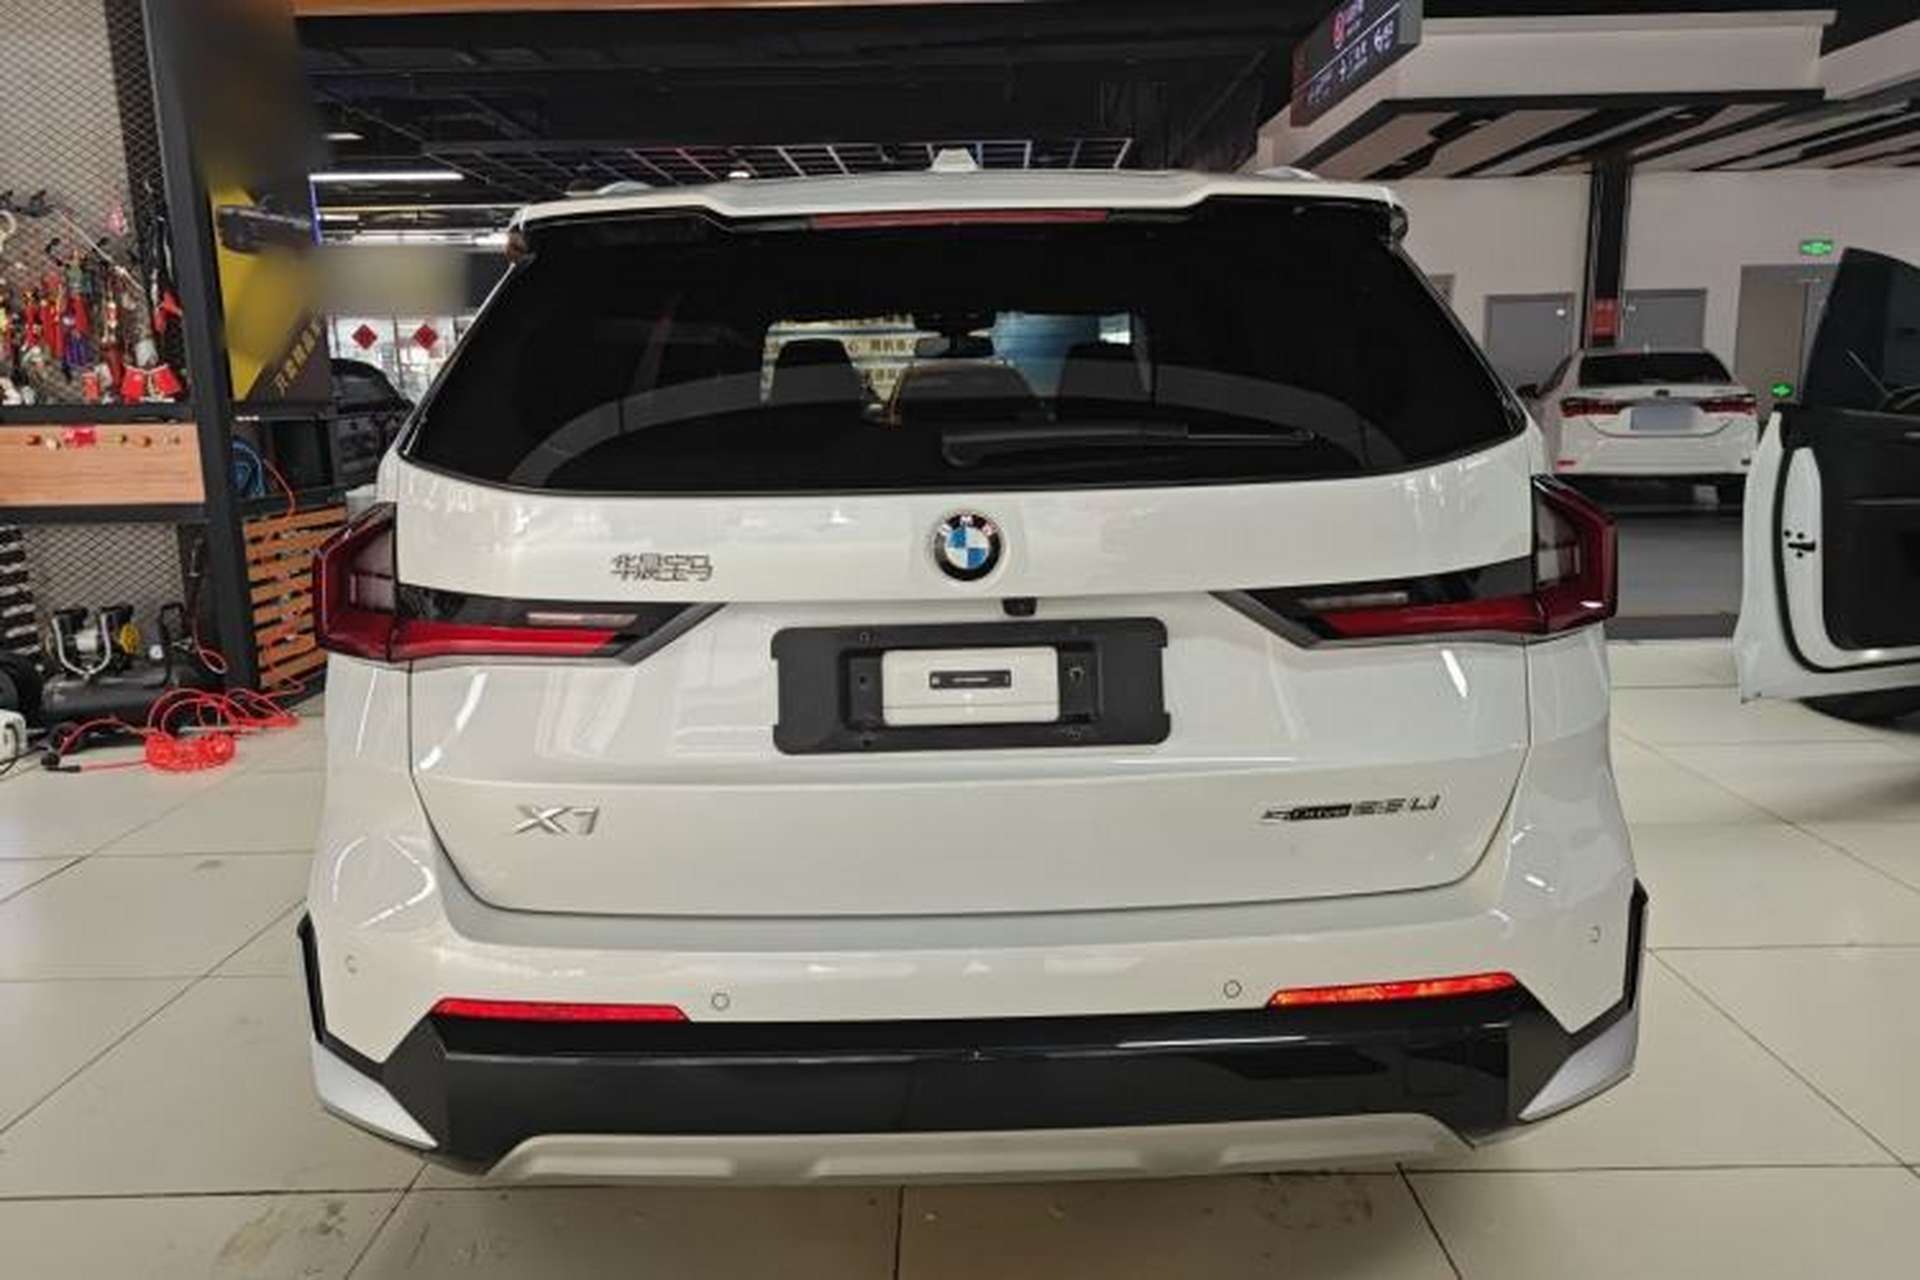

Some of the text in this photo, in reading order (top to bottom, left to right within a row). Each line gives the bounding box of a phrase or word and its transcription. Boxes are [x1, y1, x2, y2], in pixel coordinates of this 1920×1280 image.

[611, 553, 712, 581] 华晨宝马
[515, 804, 600, 835] X1
